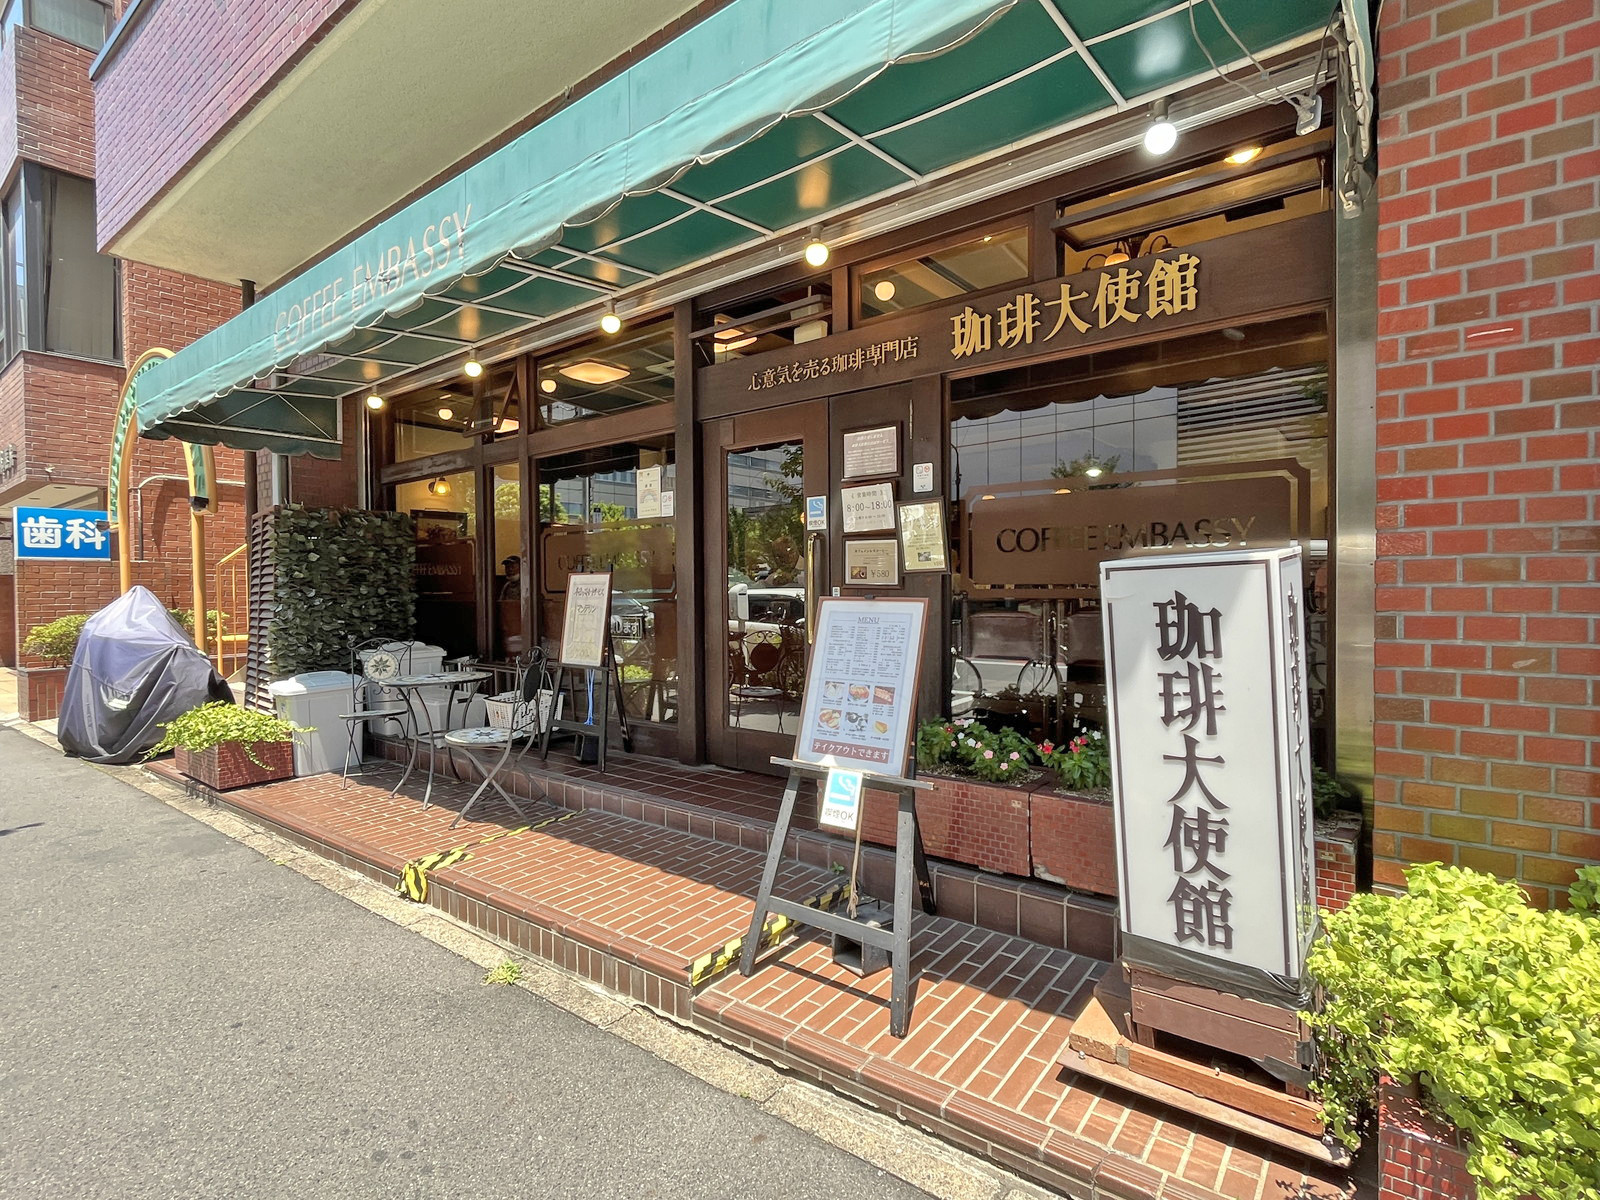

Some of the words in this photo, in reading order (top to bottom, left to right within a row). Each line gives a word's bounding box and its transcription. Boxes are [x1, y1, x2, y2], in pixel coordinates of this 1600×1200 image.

[275, 277, 343, 351] COFFEE
[351, 203, 472, 311] EMBASSY
[950, 253, 1201, 360] 珈琲大使館
[748, 336, 919, 391] 心意気を売る珈琲専門店
[20, 515, 107, 550] 歯科
[813, 741, 889, 761] テイクアウトできます
[1152, 589, 1235, 951] 珈琲大使館
